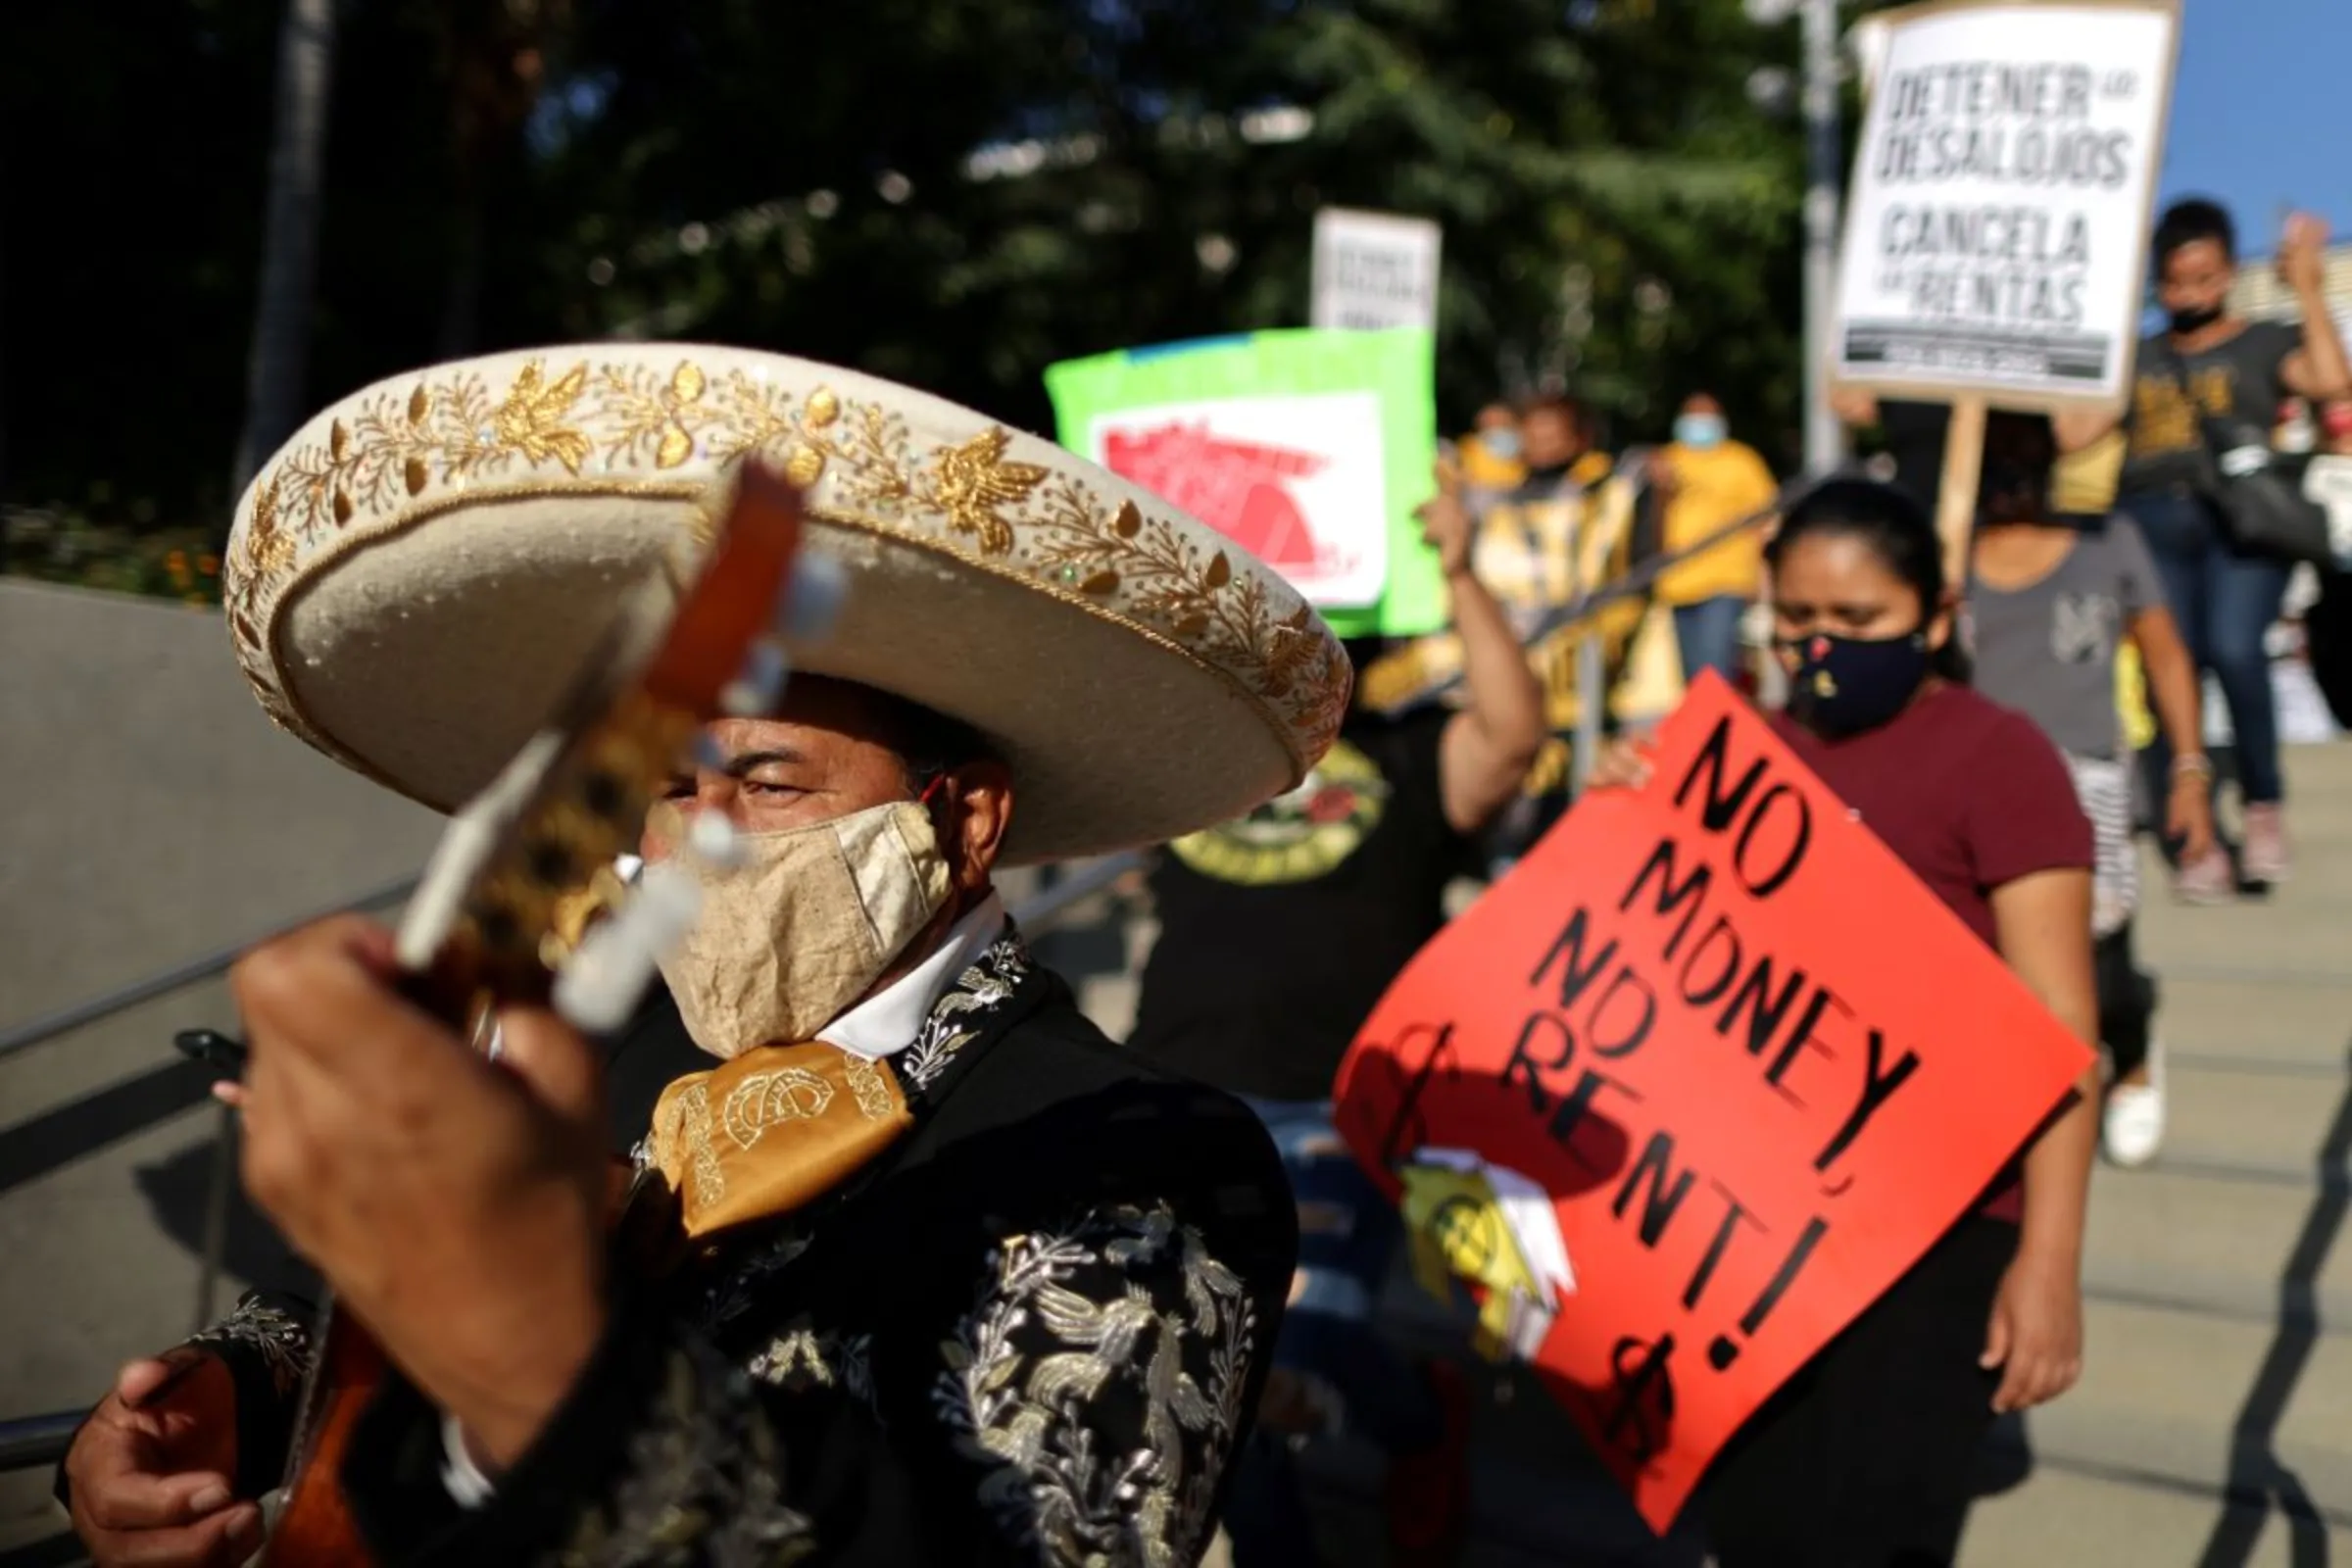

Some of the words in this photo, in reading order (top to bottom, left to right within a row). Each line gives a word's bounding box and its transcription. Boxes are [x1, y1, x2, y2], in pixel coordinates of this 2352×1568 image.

[1889, 62, 2090, 119] DETENER
[1879, 124, 2132, 190] DESALOJOS
[1882, 204, 2090, 262] CANCELA
[1911, 268, 2088, 327] RENTAS
[1674, 713, 1812, 899] NO
[1530, 906, 1658, 1058] NO
[1502, 1009, 1831, 1372] RENT!
